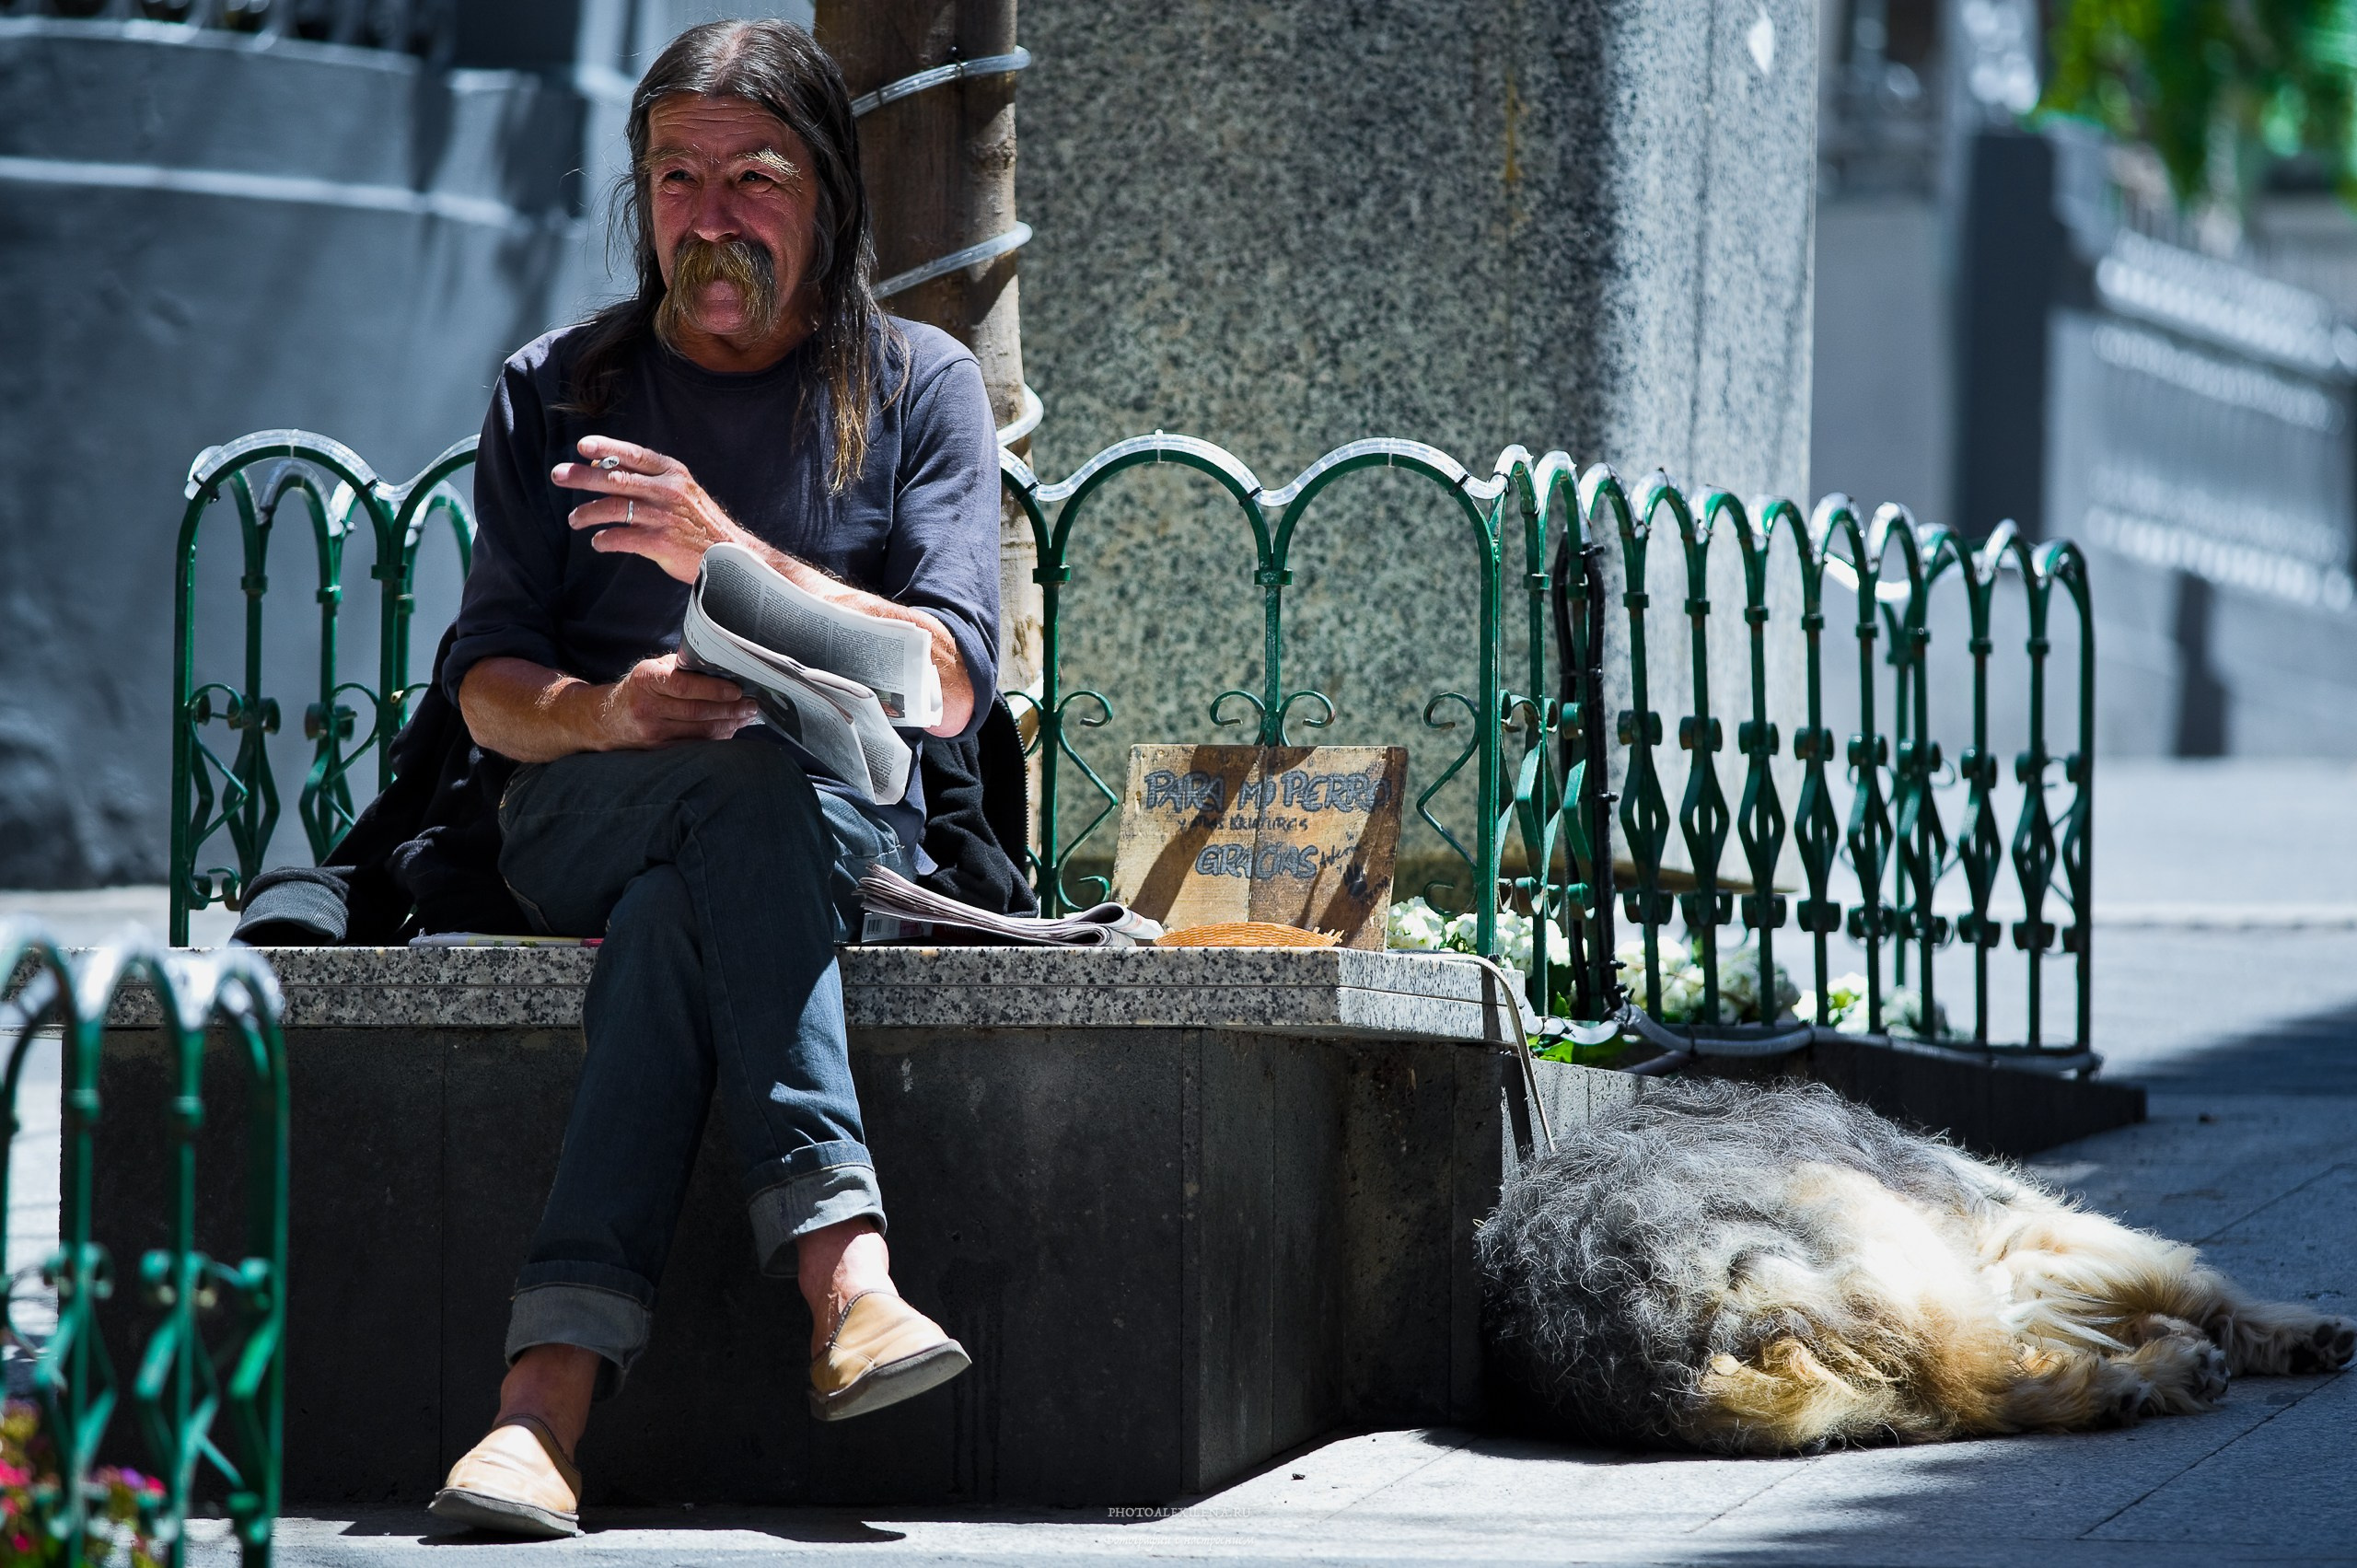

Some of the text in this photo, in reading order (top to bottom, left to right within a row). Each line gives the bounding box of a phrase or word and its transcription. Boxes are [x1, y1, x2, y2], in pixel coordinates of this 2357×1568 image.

[1144, 770, 1392, 814] PARA MI PERRO
[1195, 842, 1318, 879] GRACIAS
